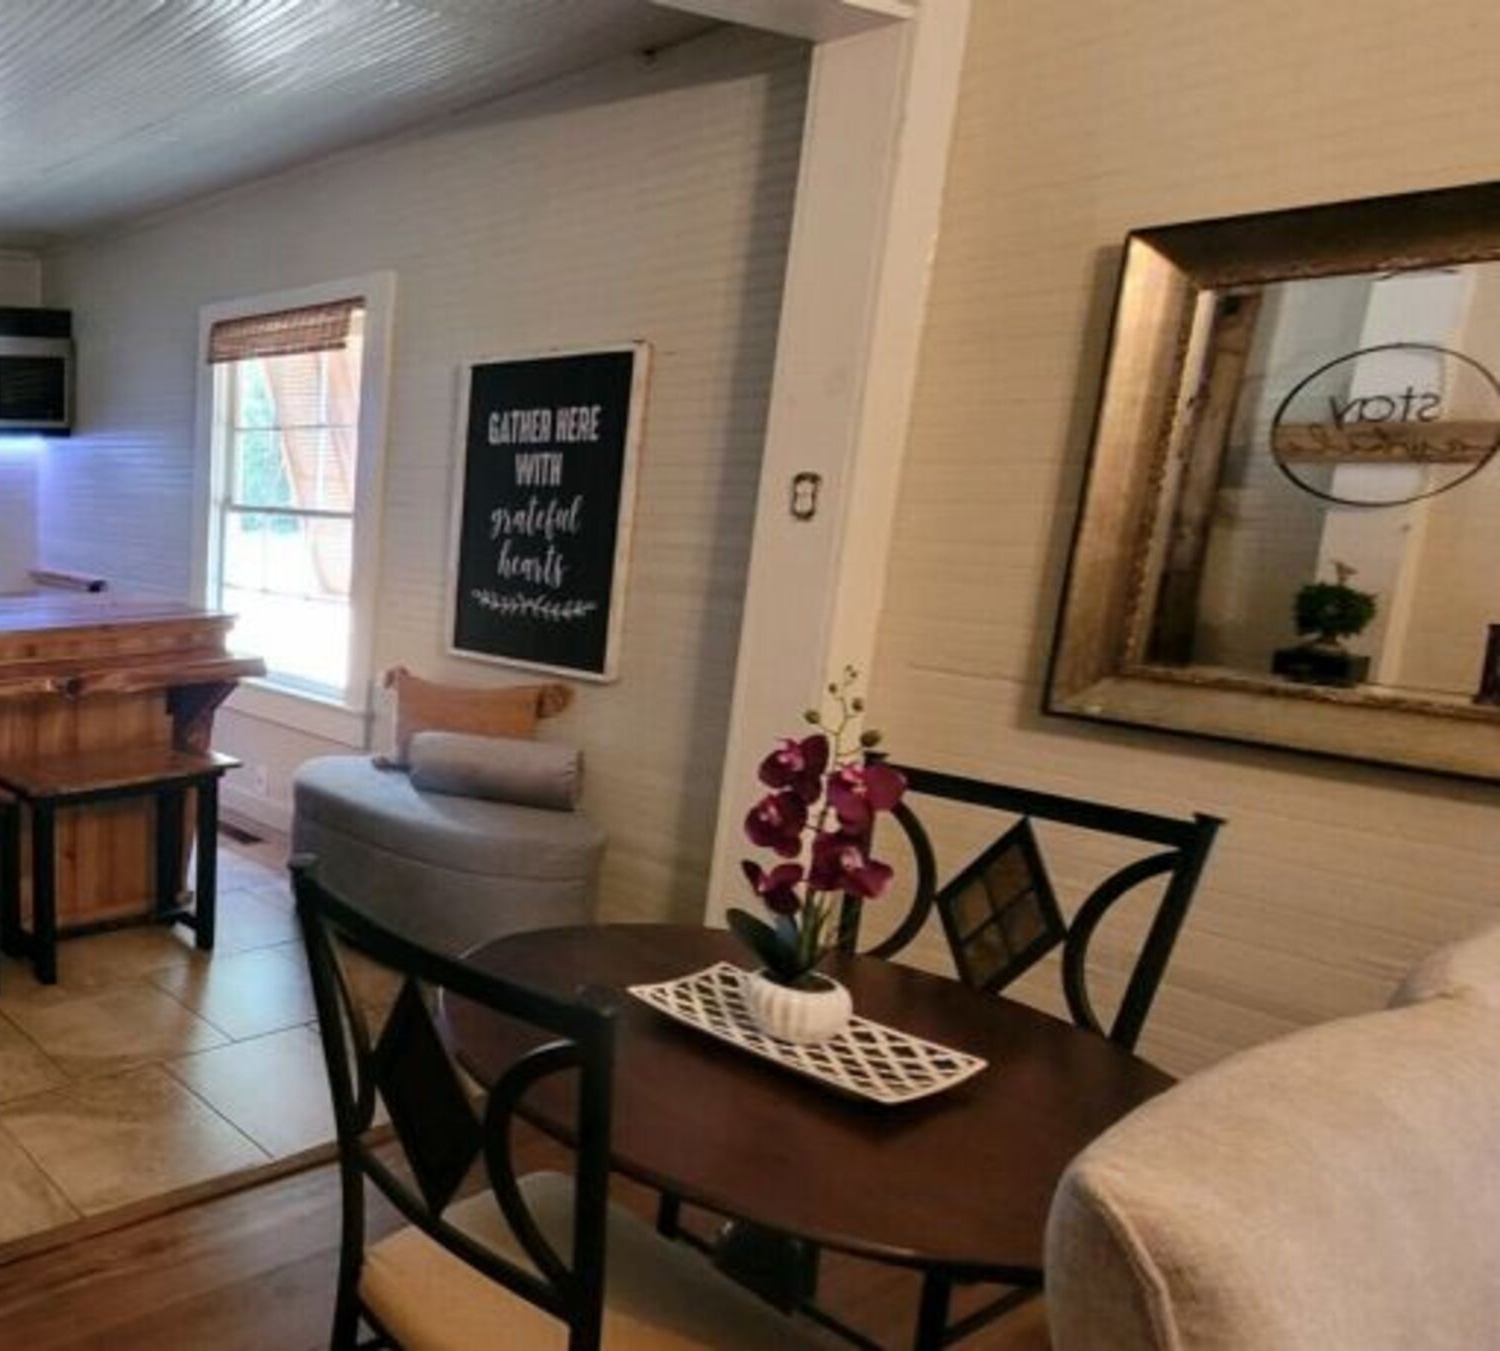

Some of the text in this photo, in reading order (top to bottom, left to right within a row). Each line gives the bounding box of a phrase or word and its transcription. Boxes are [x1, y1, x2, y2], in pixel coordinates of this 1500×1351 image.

[488, 405, 601, 445] GATHER HERE
[515, 452, 563, 486] WITH
[490, 495, 582, 540] grateful
[497, 539, 565, 588] hearts
